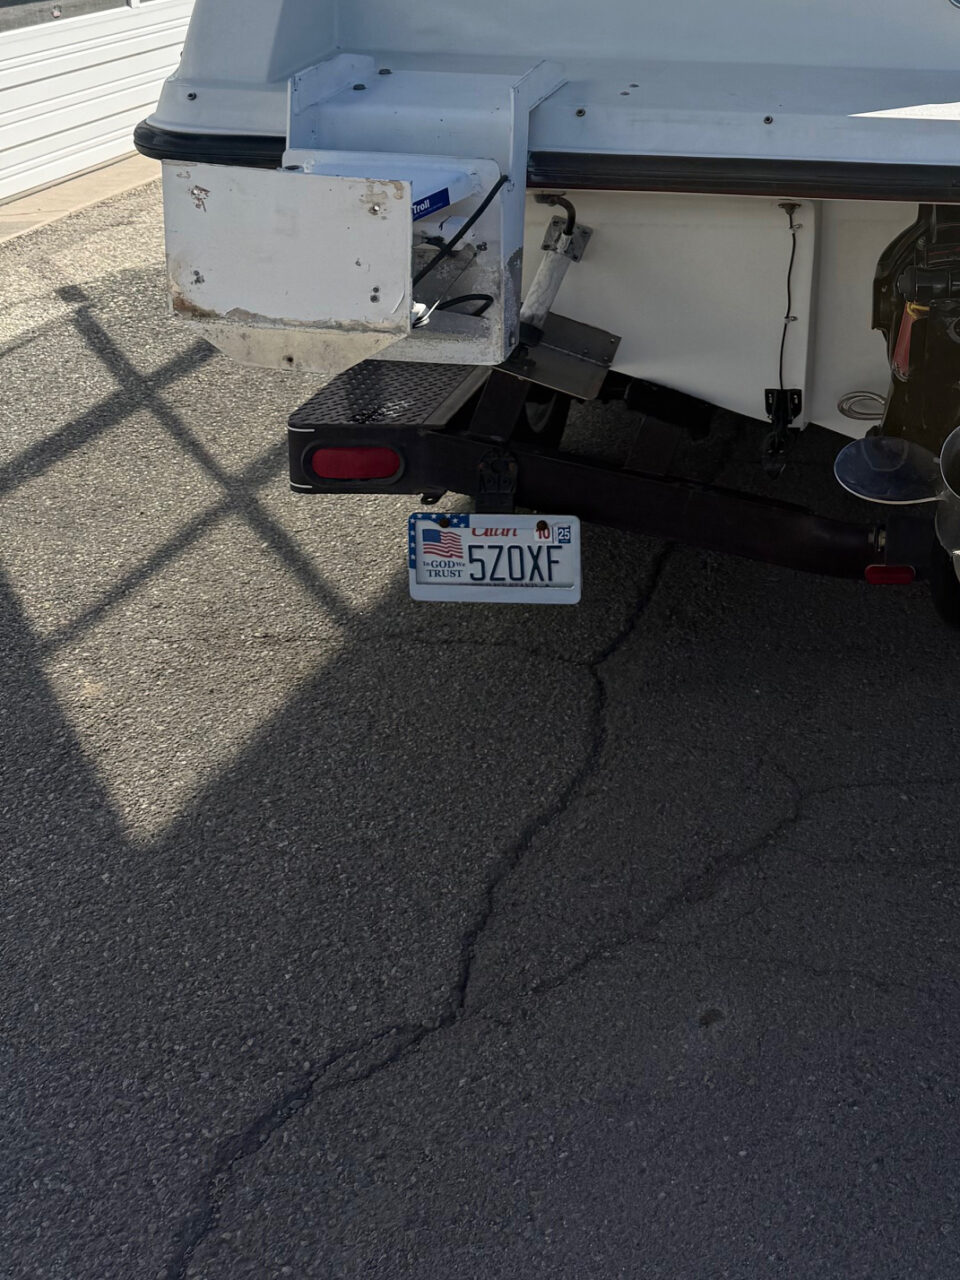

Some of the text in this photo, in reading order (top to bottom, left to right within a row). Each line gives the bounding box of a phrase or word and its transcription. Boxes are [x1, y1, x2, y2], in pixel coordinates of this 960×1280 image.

[557, 529, 570, 540] 25
[431, 560, 456, 568] GOD
[425, 569, 464, 578] TRUST
